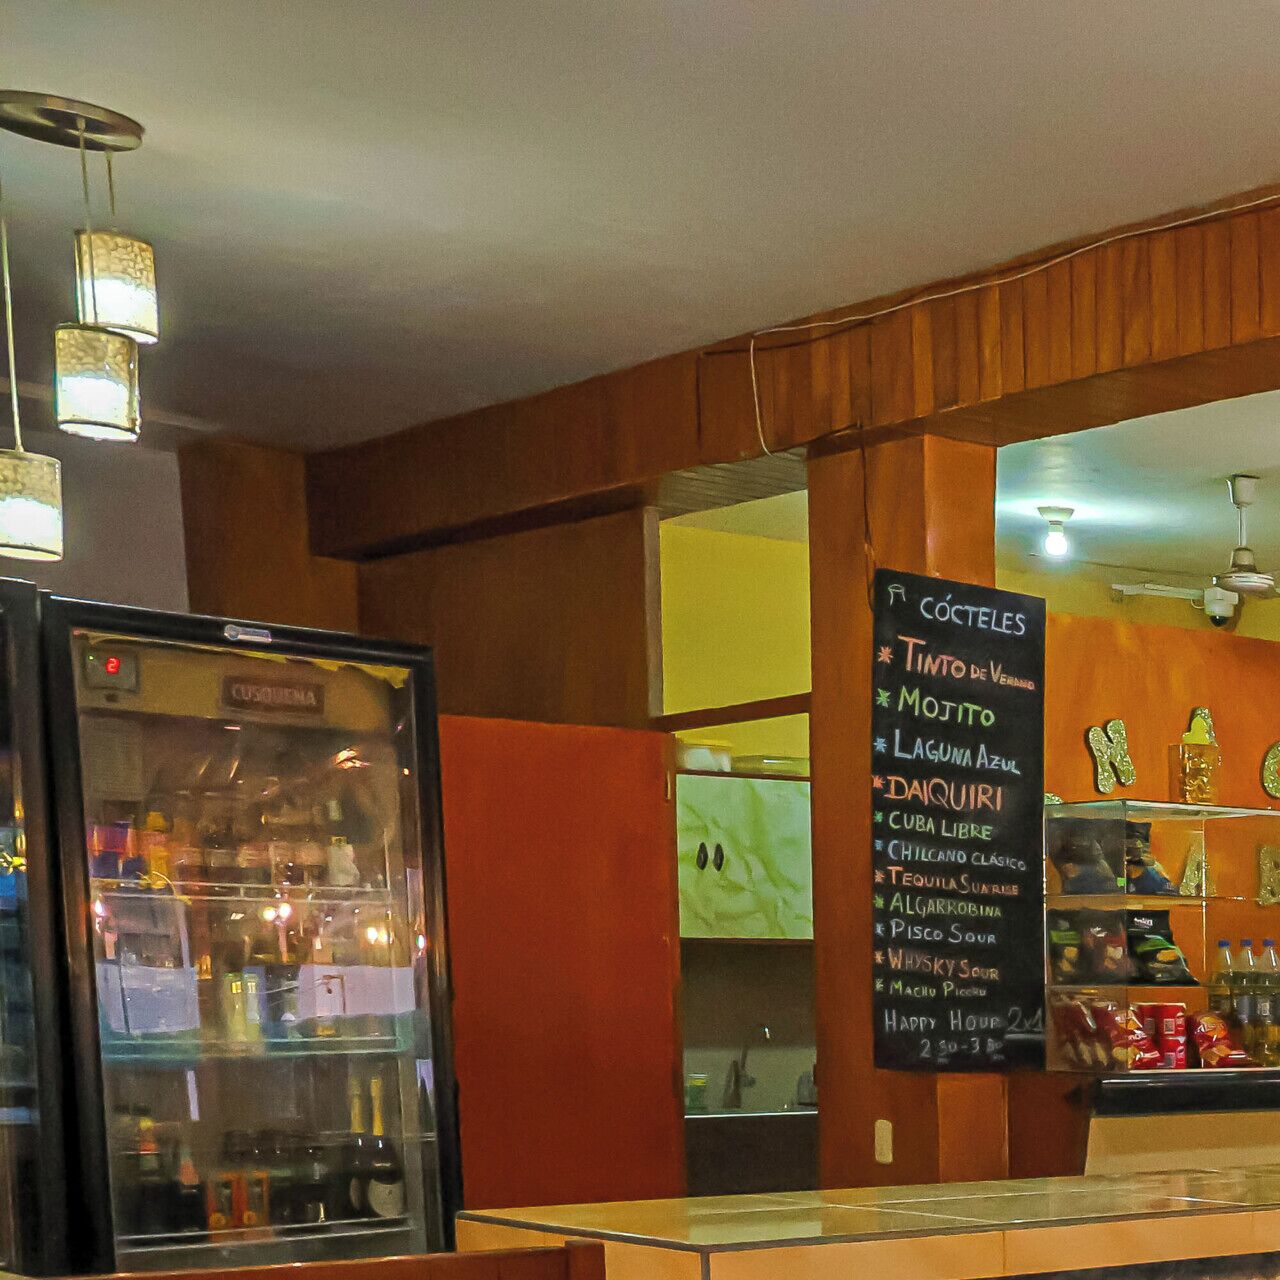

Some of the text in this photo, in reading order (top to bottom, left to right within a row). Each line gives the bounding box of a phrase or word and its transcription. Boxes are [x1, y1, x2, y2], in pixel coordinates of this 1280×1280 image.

[920, 594, 1026, 635] CÓCTELES
[898, 635, 966, 679] TINTO
[971, 664, 987, 680] DE
[898, 685, 996, 727] MOJITO
[895, 729, 1020, 774] LAGUNA AZUL
[884, 775, 1002, 811] DAIQUIRI
[889, 811, 993, 841] CUBA LIBRE
[887, 839, 1027, 871] CHILCANO CLÁSICO
[887, 866, 957, 890] TEQUILA
[889, 892, 1002, 918] ALGARROBINA
[890, 918, 996, 944] PISCO SOUR
[958, 959, 999, 981] SOUR
[890, 981, 937, 997] MACHU
[885, 1009, 936, 1032] HAPPY
[950, 1009, 1003, 1031] HOUR
